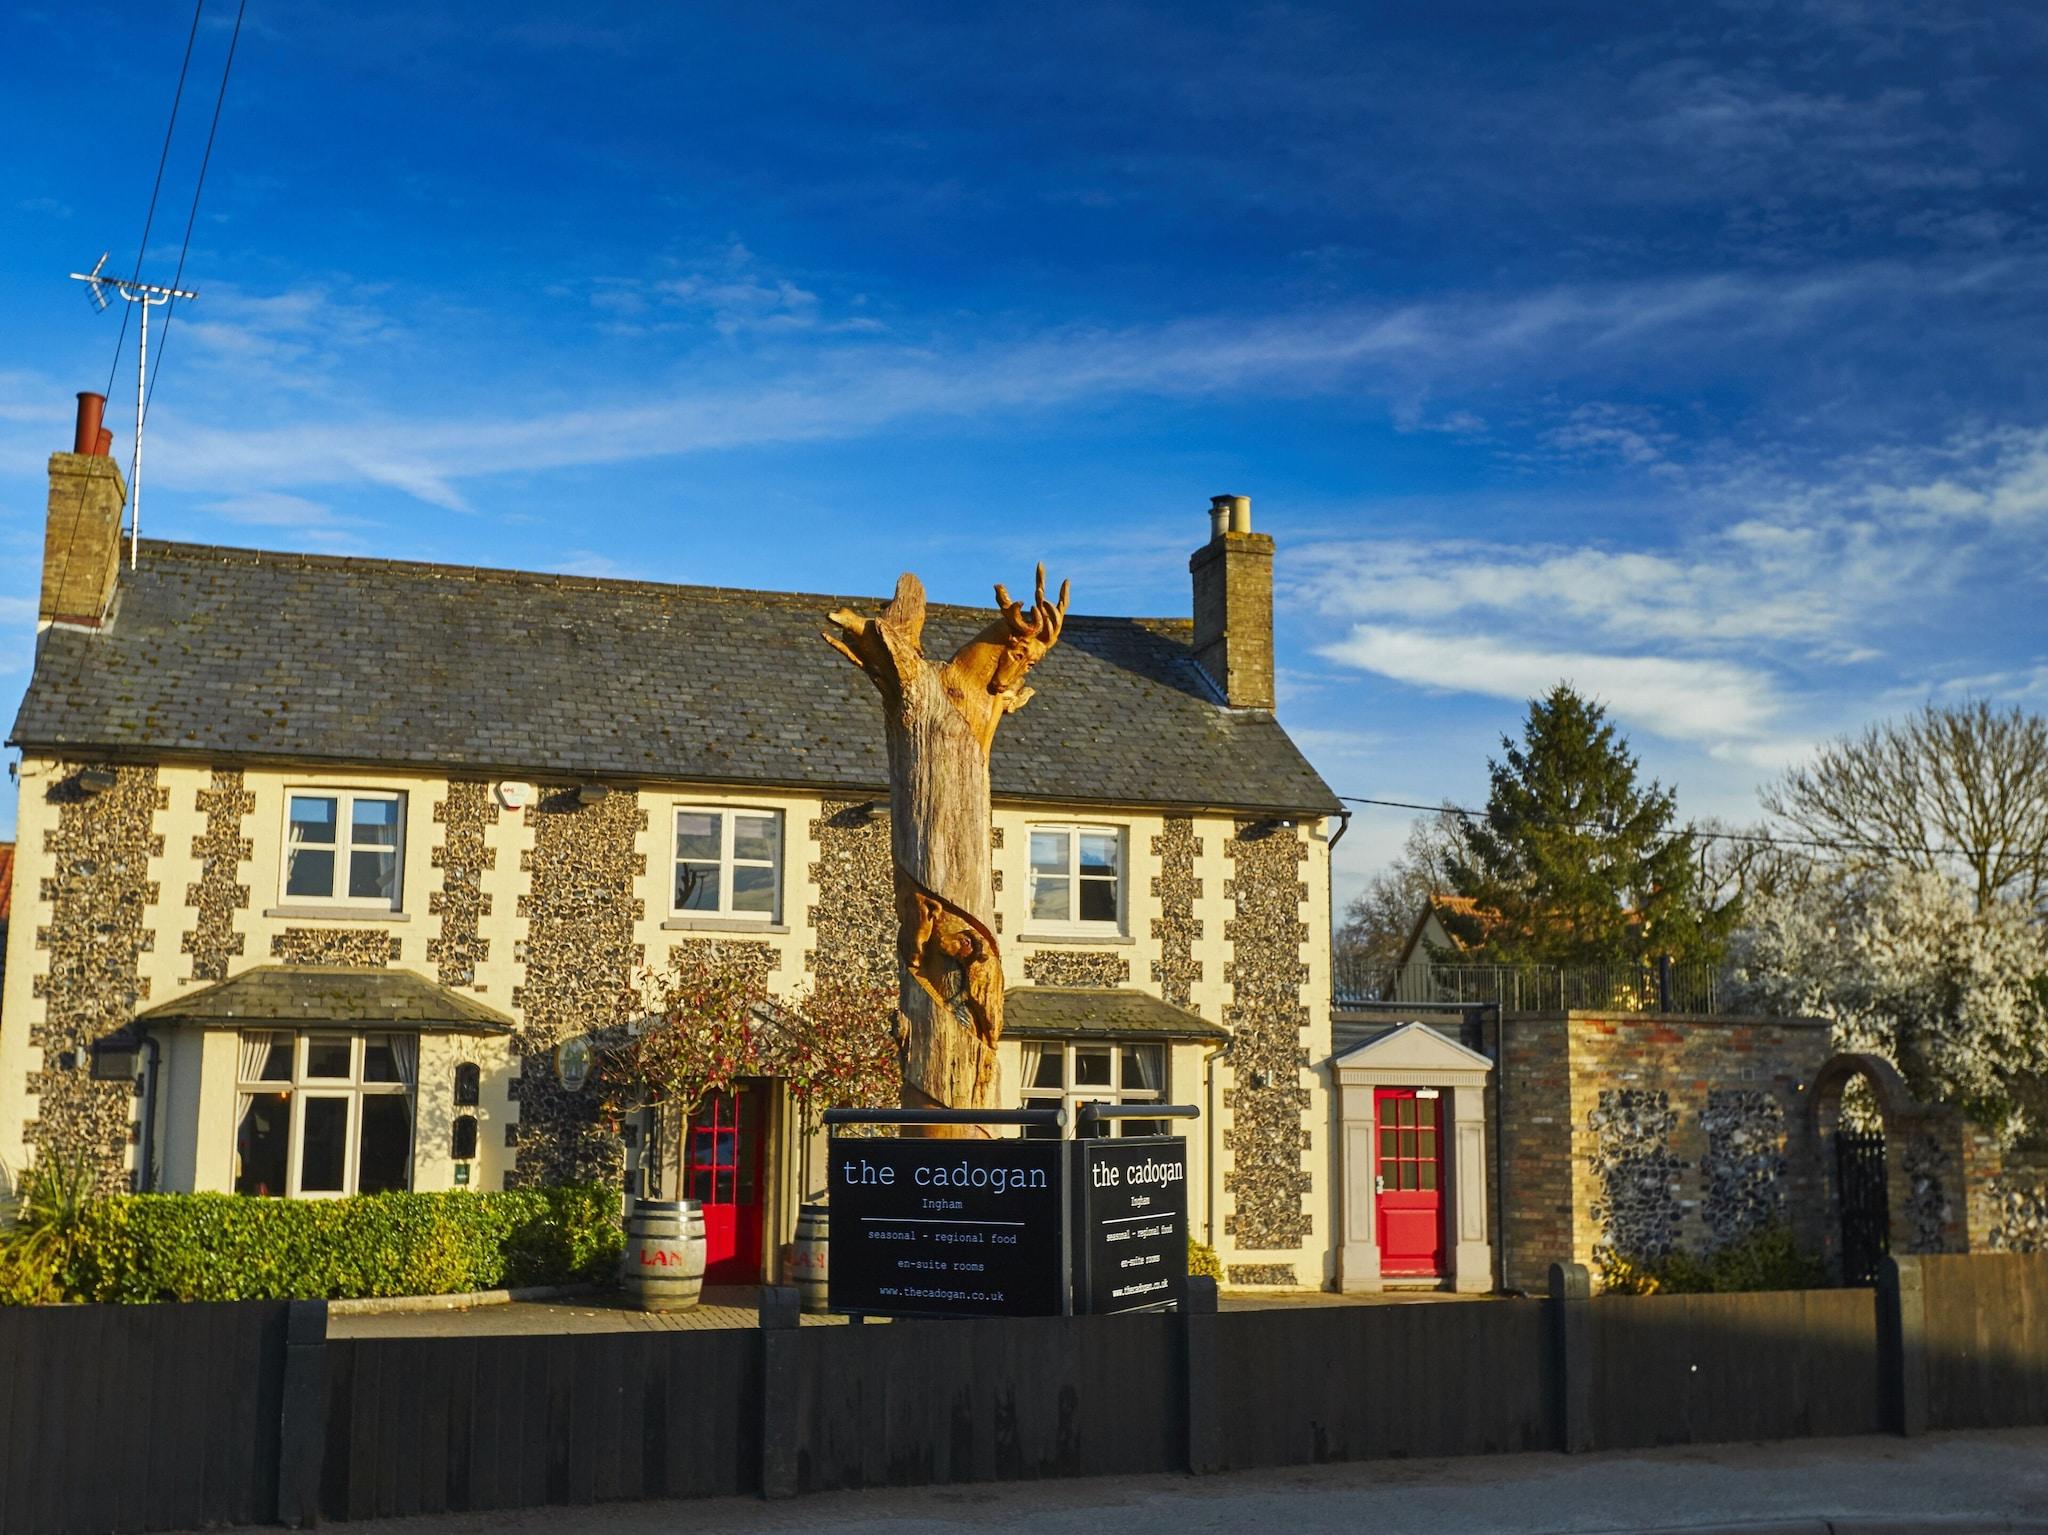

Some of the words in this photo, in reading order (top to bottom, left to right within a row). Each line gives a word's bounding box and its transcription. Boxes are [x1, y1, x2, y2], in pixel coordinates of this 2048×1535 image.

[843, 1159, 895, 1186] the
[914, 1160, 1048, 1195] cadogan
[1092, 1161, 1119, 1188] the
[1127, 1158, 1183, 1188] cadogan
[922, 1198, 963, 1212] Ingham
[868, 1230, 917, 1241] seasonal
[935, 1232, 985, 1244] regional
[991, 1233, 1017, 1245] food
[897, 1259, 948, 1271] en-suite
[953, 1262, 985, 1272] rooms
[879, 1286, 1005, 1302] www.thecadogan.co.uk
